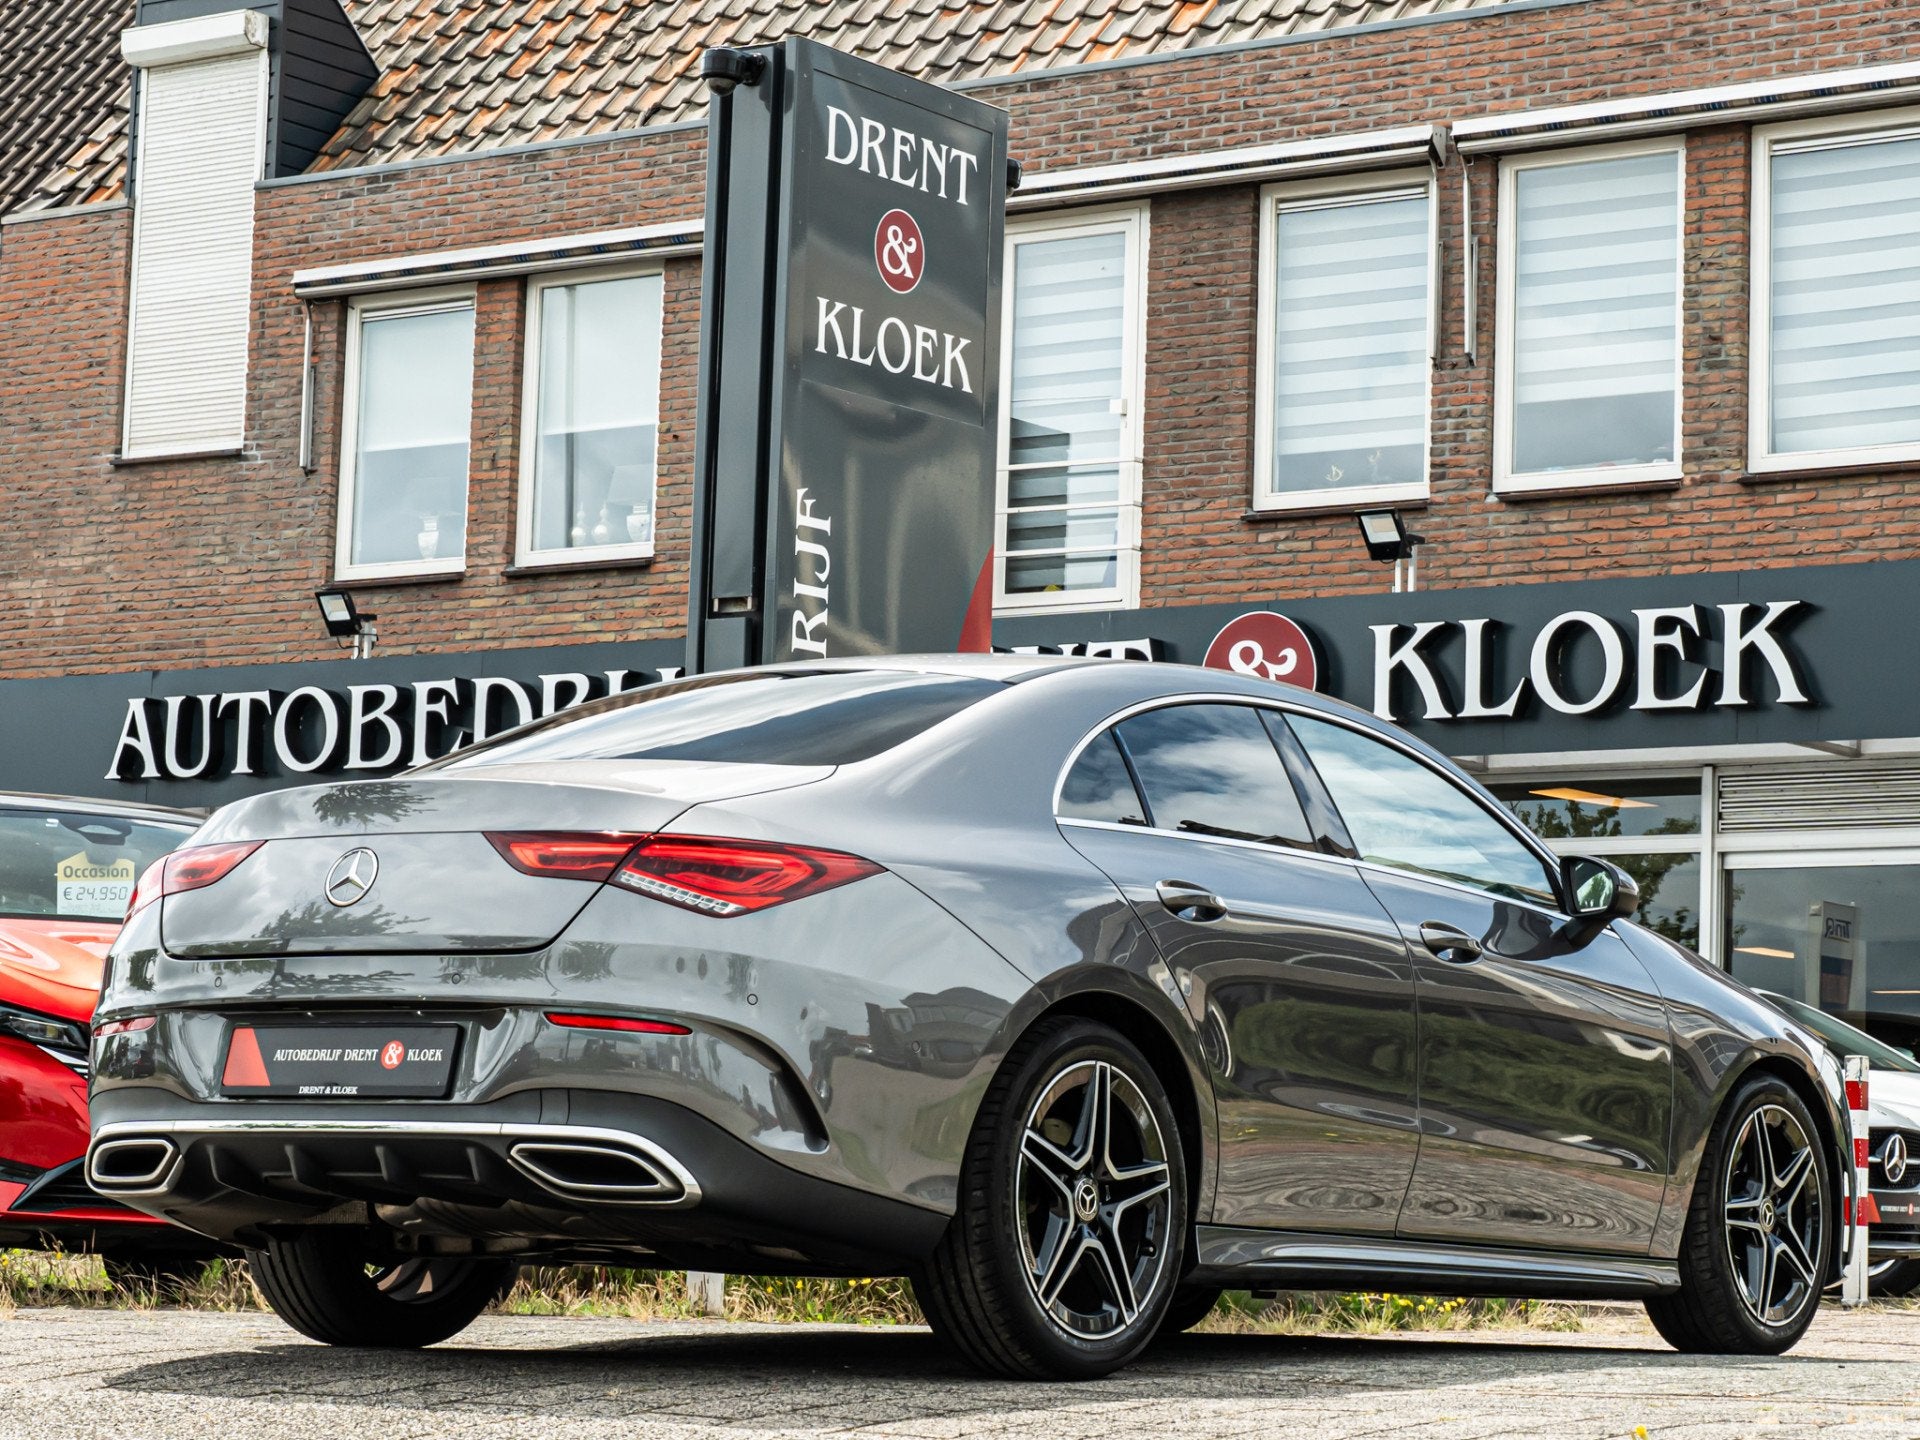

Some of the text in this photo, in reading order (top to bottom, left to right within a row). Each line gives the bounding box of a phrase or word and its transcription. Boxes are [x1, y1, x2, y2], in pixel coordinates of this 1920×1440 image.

[824, 105, 978, 206] DRENT
[882, 224, 917, 279] &
[814, 296, 974, 394] KLOEK
[103, 666, 682, 780] AUTOBED
[1368, 600, 1809, 722] KLOEK
[63, 865, 129, 878] Occasion
[63, 886, 128, 901] € 24.950
[273, 1043, 443, 1065] AUTOBEDRIJF DRENT & KLOEK
[298, 1086, 358, 1095] DRENT & KLOEK
